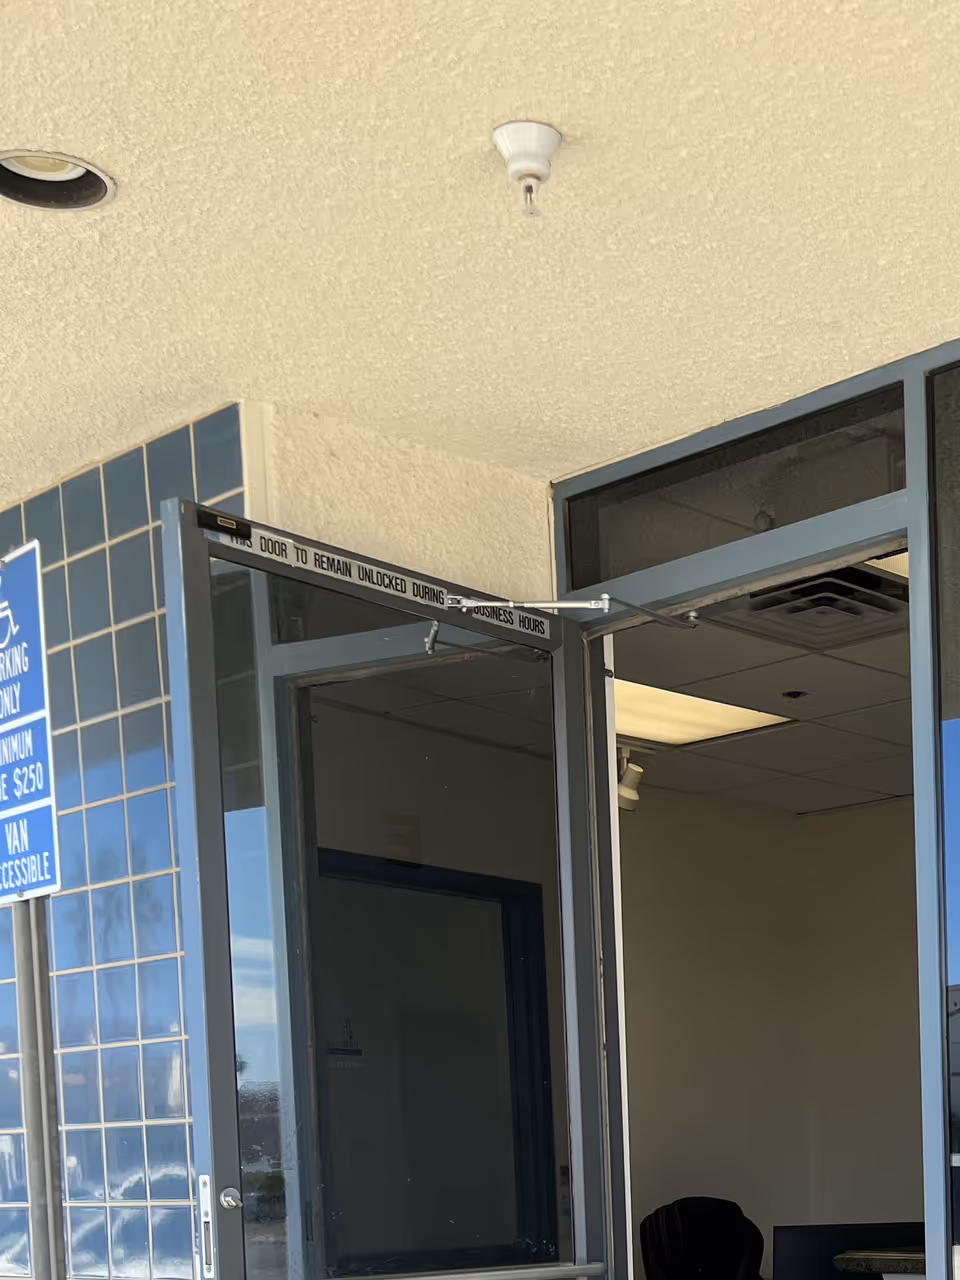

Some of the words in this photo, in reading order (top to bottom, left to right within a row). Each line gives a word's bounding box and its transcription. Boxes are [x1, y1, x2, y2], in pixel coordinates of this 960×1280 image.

[260, 535, 288, 559] DOOR
[294, 544, 308, 564] TO
[314, 553, 352, 578] REMAIN
[358, 565, 406, 594] UNLOCKED
[412, 582, 445, 606] DURING
[473, 605, 514, 626] BUSINESS
[519, 614, 545, 635] HOURS
[13, 761, 43, 801] $250
[5, 818, 29, 855] VAN
[0, 851, 51, 890] CESSIBLE
